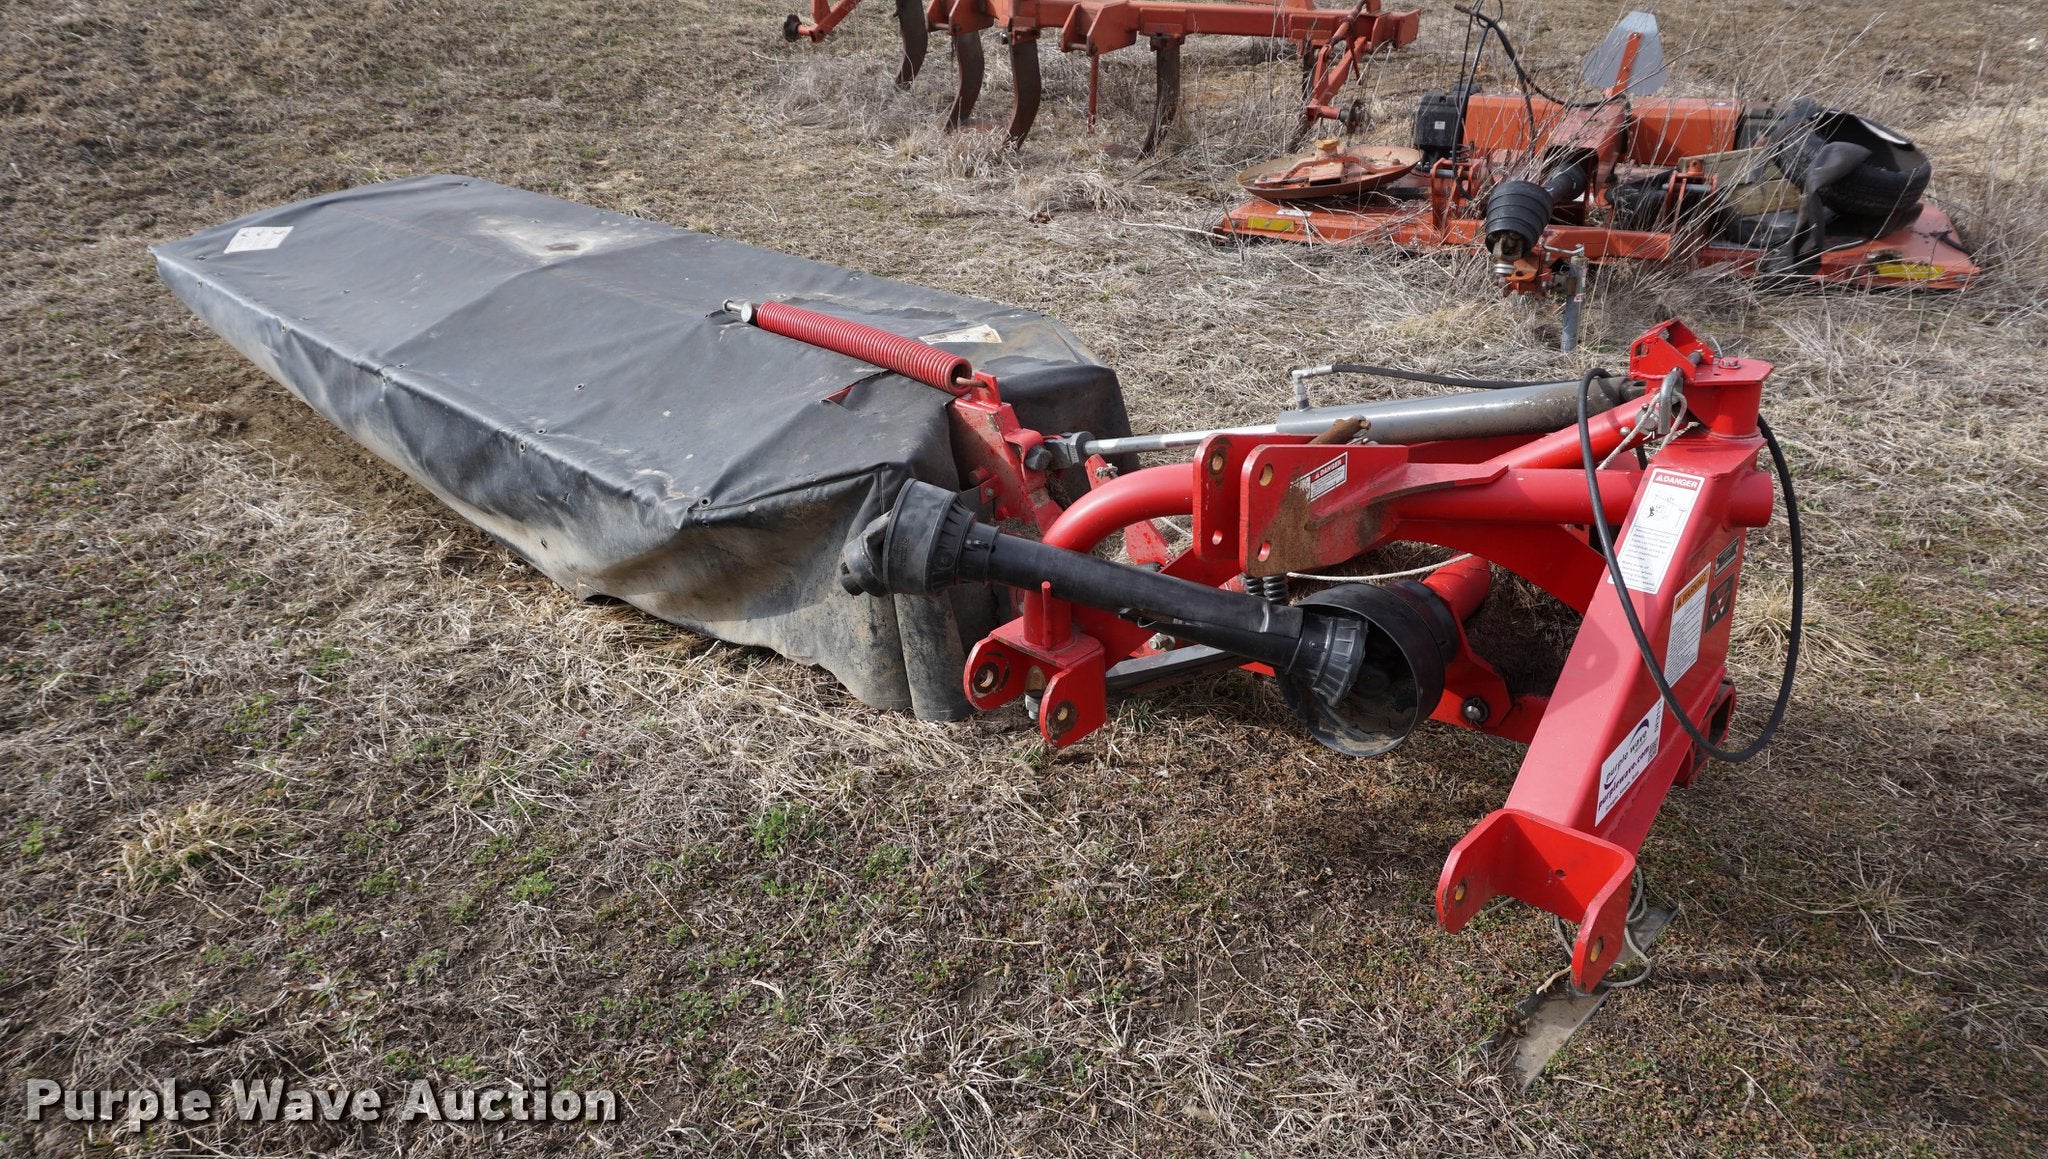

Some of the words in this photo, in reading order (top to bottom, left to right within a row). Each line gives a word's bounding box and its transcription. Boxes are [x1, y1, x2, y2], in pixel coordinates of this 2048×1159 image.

[1320, 459, 1342, 476] DANGER
[1663, 476, 1698, 489] DANGER
[1605, 750, 1629, 783] purple
[1630, 730, 1648, 754] wave
[1597, 745, 1650, 811] purplewave.com
